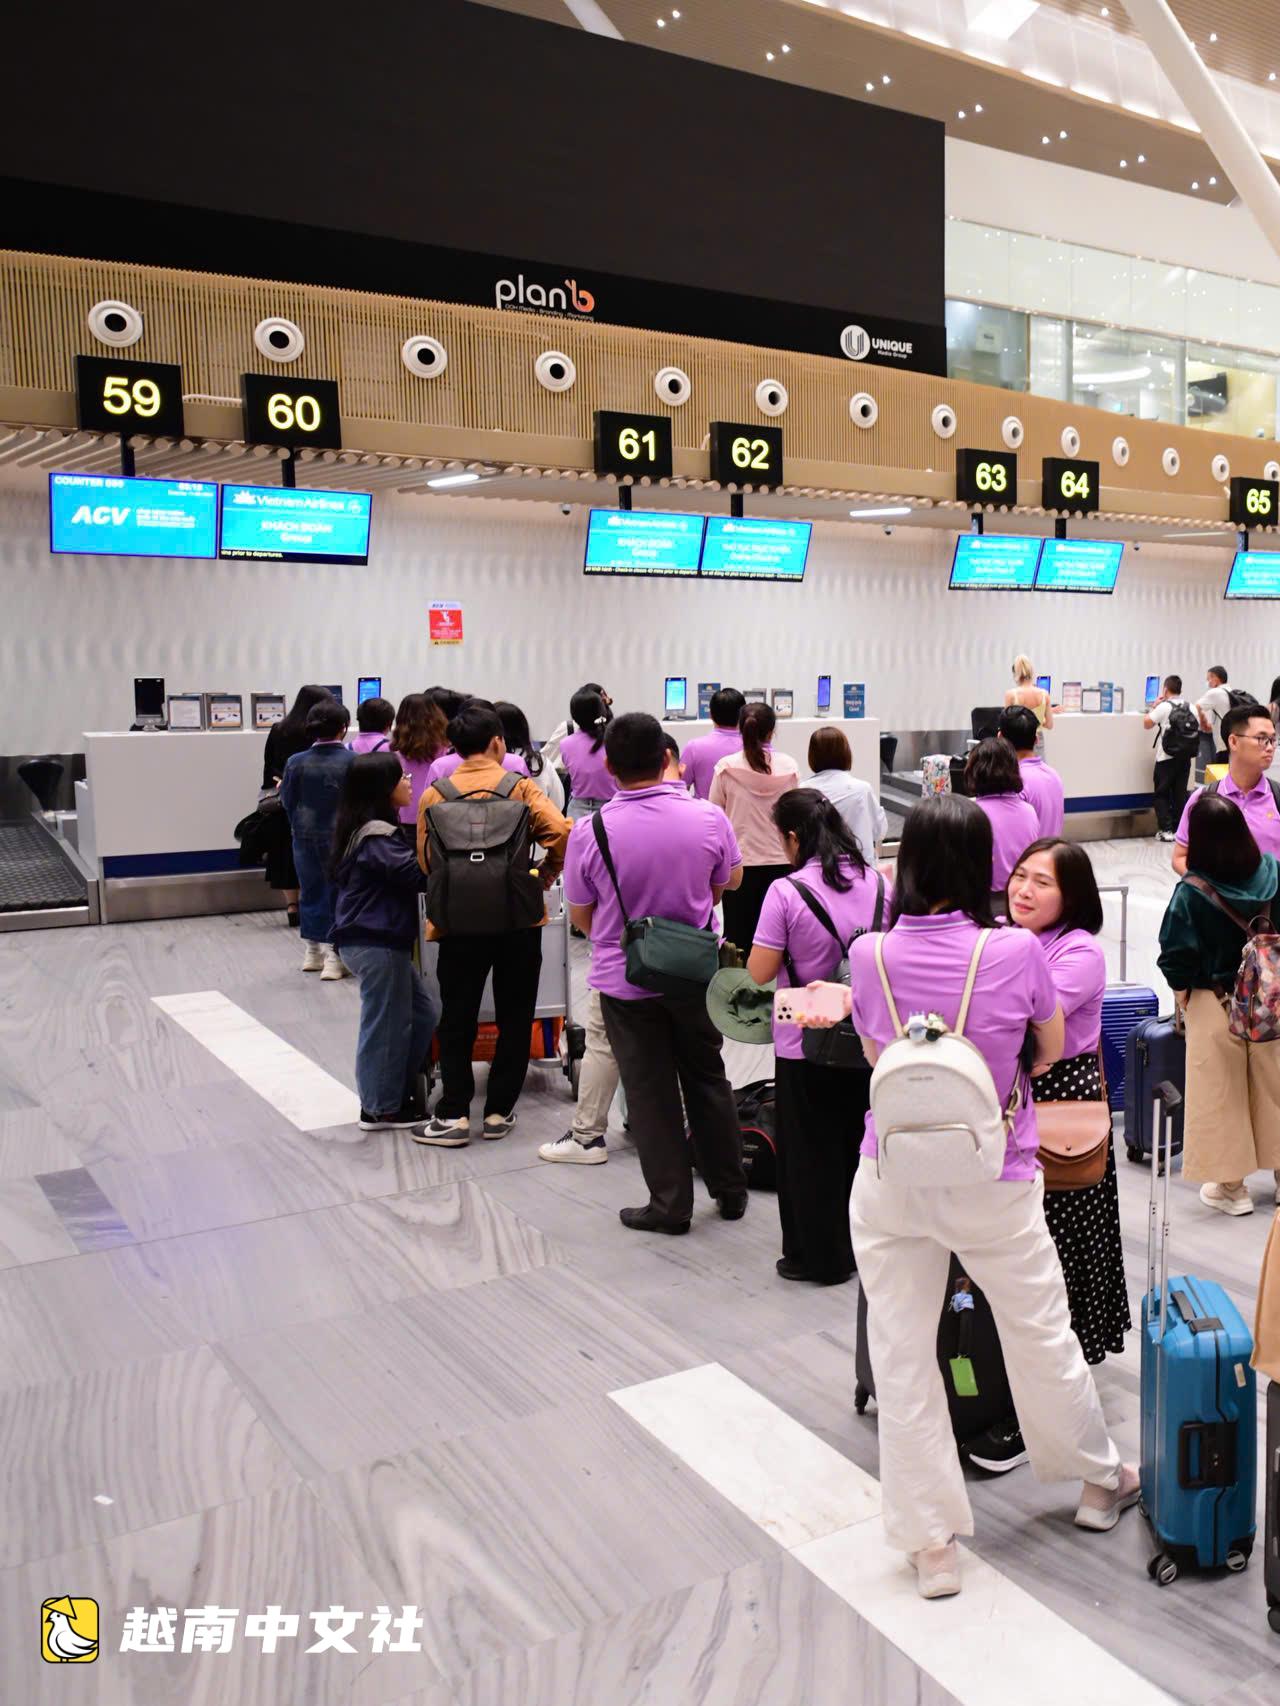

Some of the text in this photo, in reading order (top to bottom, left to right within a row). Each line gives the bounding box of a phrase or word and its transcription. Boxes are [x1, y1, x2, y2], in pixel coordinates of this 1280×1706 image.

[872, 338, 913, 353] UNIQUE
[103, 376, 161, 417] 59
[267, 393, 321, 431] 60
[618, 428, 656, 462] 61
[731, 437, 770, 470] 62
[54, 476, 104, 488] COUNTER
[976, 462, 1007, 492] 63
[1061, 471, 1089, 499] 64
[71, 505, 131, 526] ACV
[1246, 489, 1271, 514] 65
